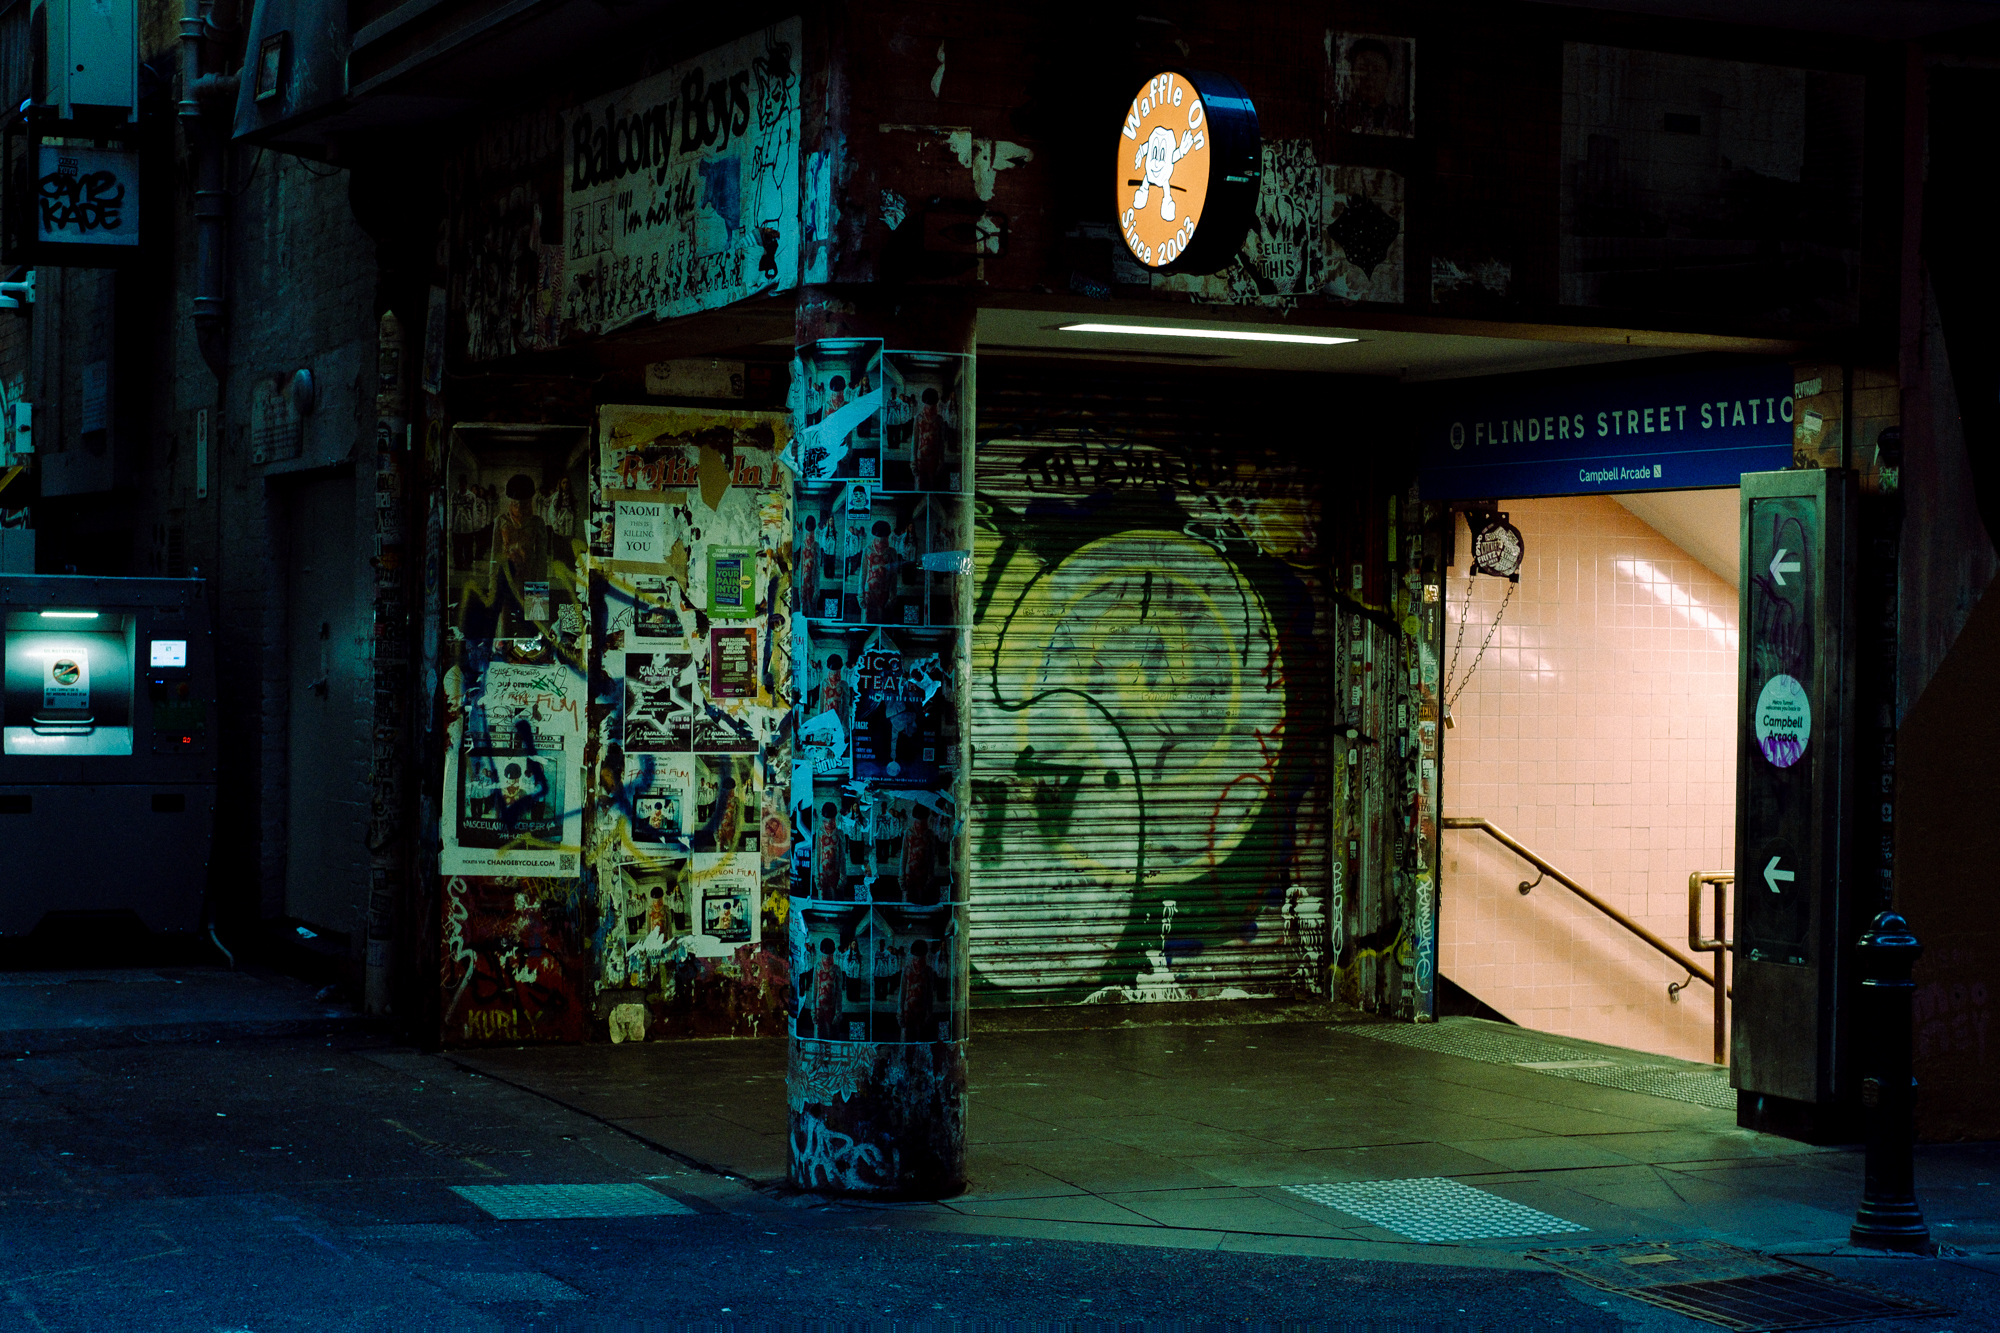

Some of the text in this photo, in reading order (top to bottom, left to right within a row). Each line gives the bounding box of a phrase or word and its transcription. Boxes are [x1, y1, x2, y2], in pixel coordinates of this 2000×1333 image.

[1122, 73, 1205, 151] Waffle On
[571, 98, 677, 192] Balcony
[680, 67, 750, 155] Boys
[646, 184, 672, 230] not
[674, 167, 695, 219] the
[1122, 207, 1195, 266] Since 2003
[1256, 242, 1292, 256] SELFIE
[1260, 260, 1295, 279] THIS
[1475, 395, 1794, 446] FLINDERS STREET STATIO
[1579, 465, 1651, 485] Campbell Arcade
[619, 505, 660, 516] NAOMI
[623, 529, 654, 538] KILLING
[626, 541, 651, 552] YOU
[1477, 550, 1497, 564] FRITZ
[716, 577, 740, 585] PAIN
[716, 586, 739, 594] INTO
[1763, 715, 1803, 730] Campbell
[1768, 729, 1798, 742] Arcade
[468, 1008, 543, 1040] KURLY
